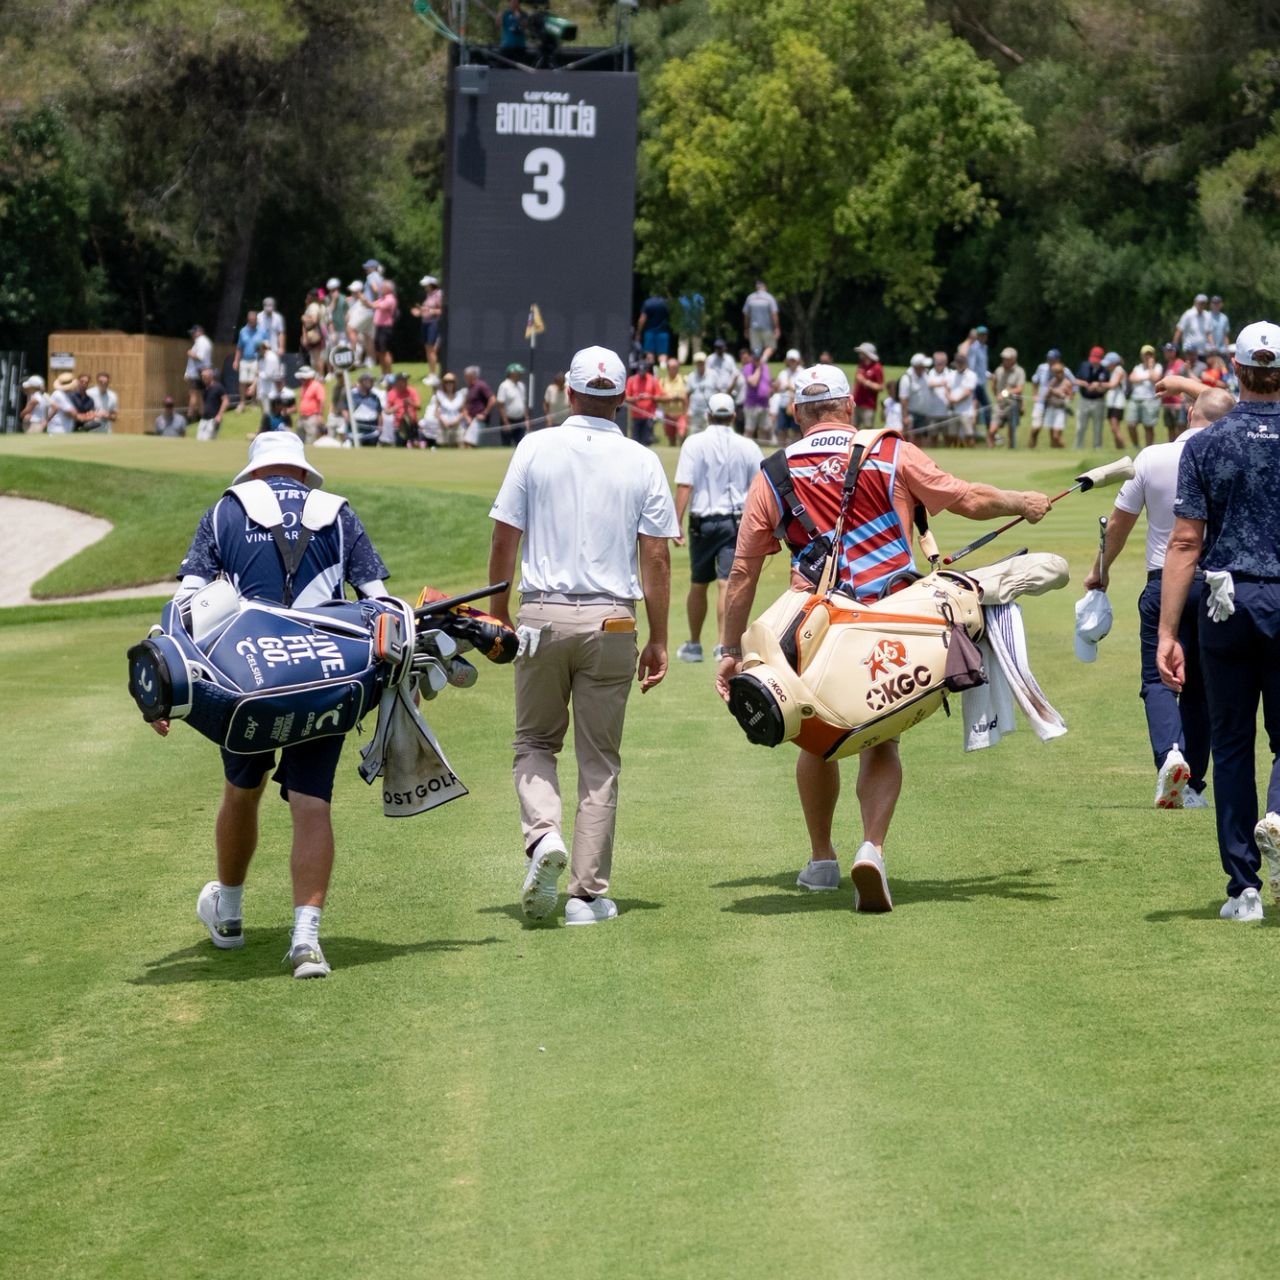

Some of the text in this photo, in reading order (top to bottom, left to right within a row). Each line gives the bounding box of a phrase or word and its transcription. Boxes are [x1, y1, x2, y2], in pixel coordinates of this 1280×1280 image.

[522, 147, 565, 221] 3
[257, 637, 291, 668] GO.
[281, 635, 318, 664] FIT.
[245, 653, 264, 686] CELSIUS
